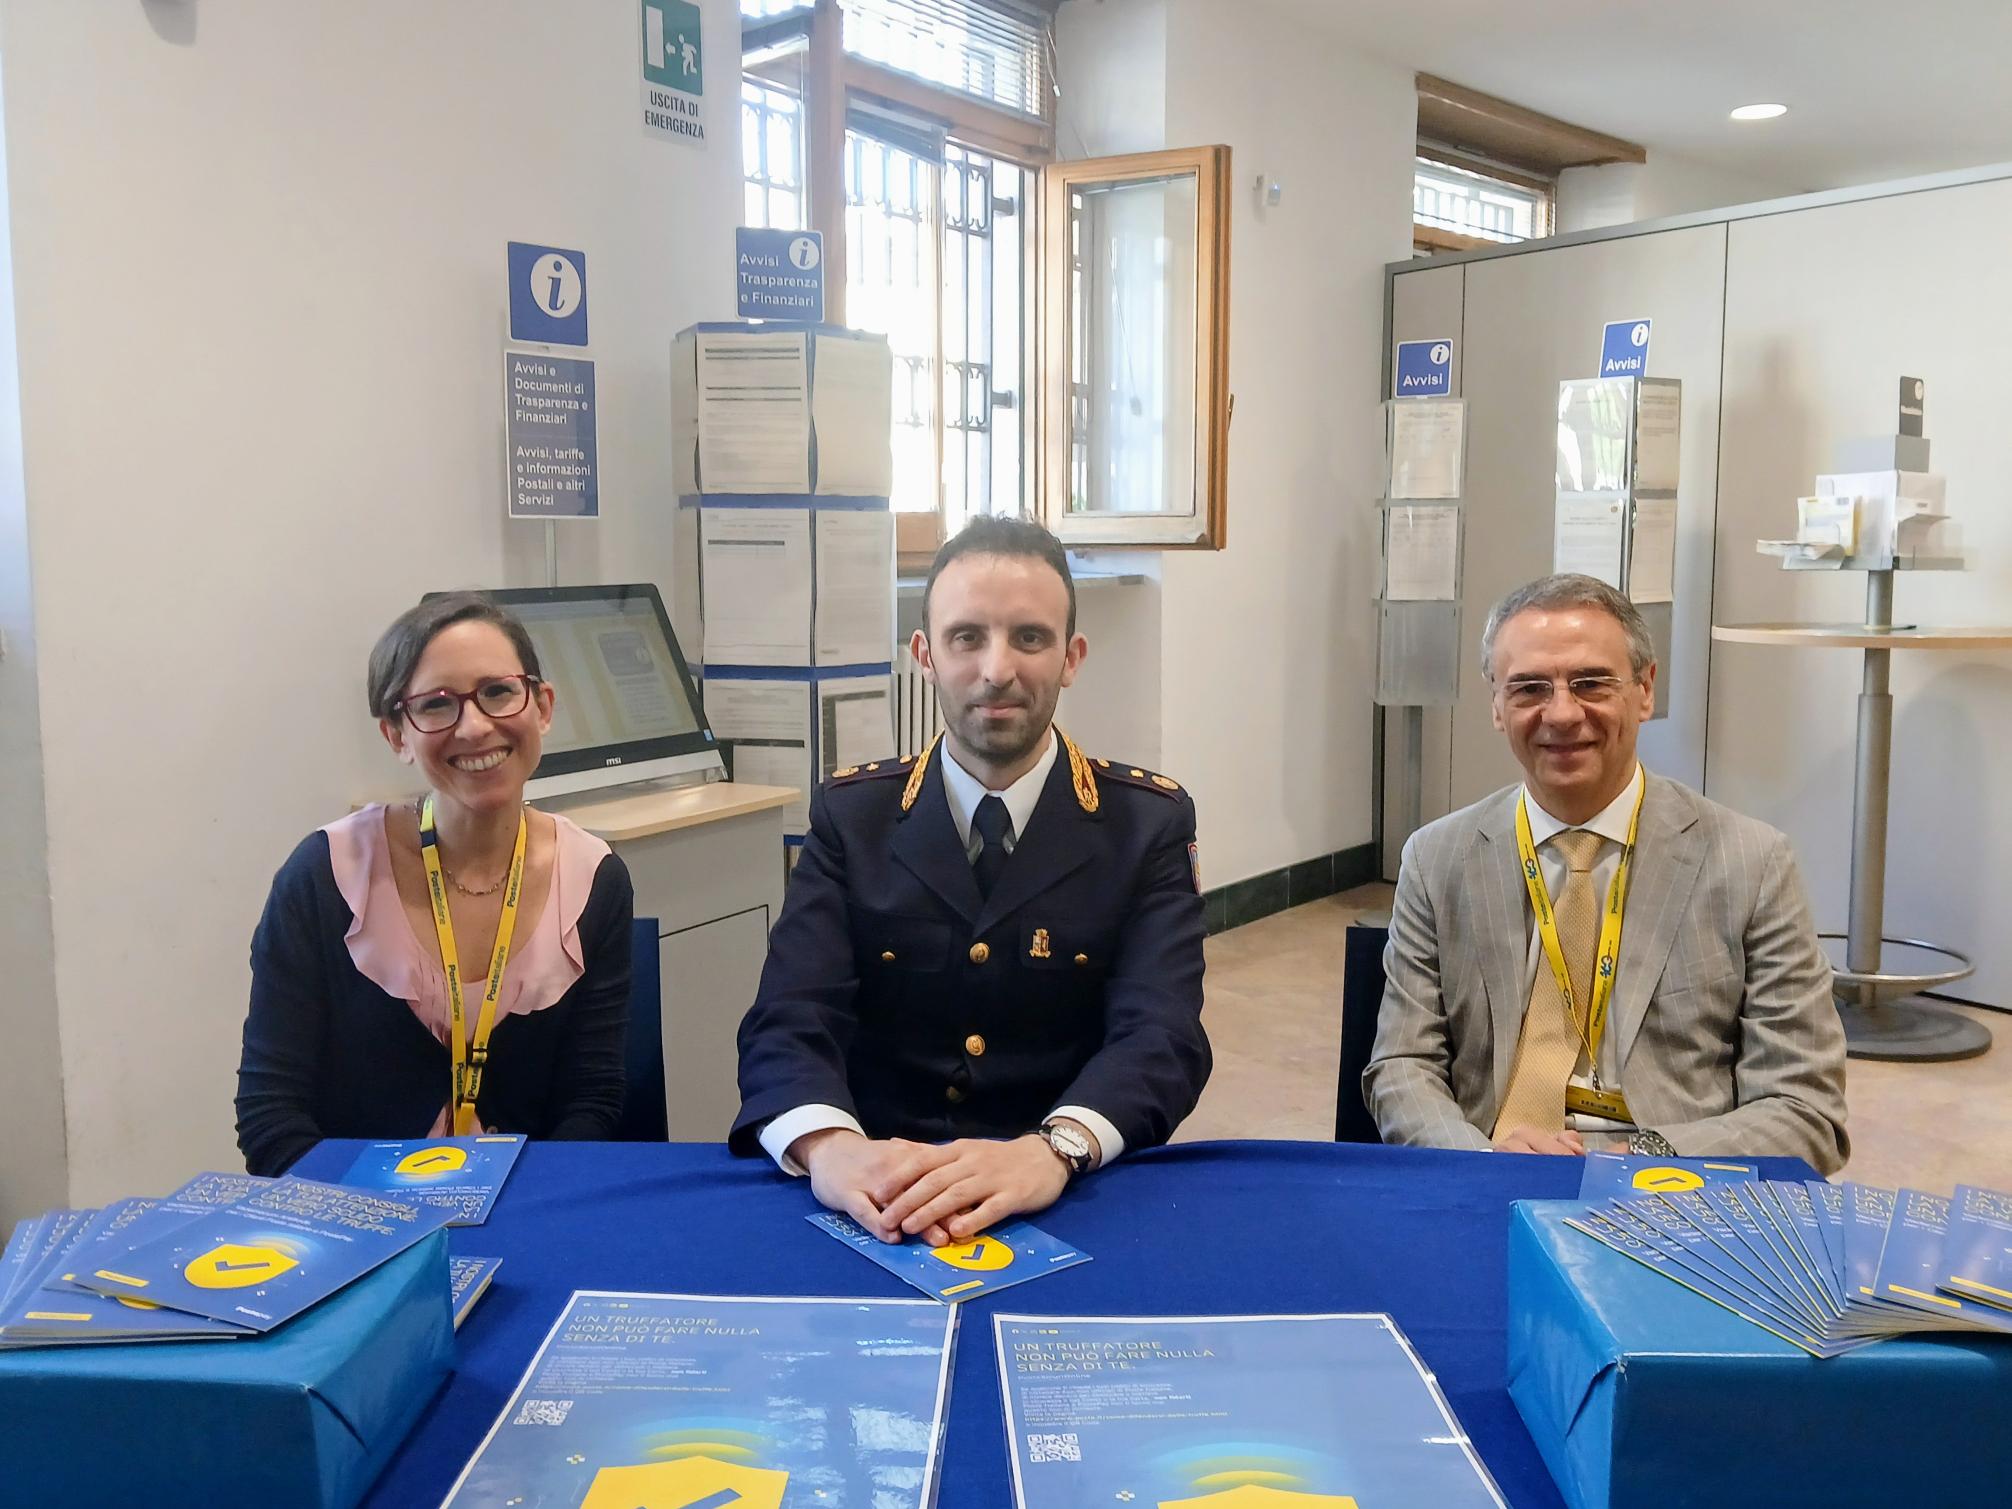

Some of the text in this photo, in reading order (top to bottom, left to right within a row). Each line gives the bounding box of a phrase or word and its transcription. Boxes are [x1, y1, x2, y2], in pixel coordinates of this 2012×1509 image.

[650, 90, 698, 117] USCITA DI
[645, 110, 704, 139] EMERGENZA
[740, 253, 779, 267] Avvisi
[740, 272, 818, 288] Trasparenza
[741, 292, 814, 307] e Finanziari
[515, 361, 556, 376] Avvisi e
[1605, 355, 1641, 372] Avvisi
[515, 378, 584, 394] Documenti di
[1402, 373, 1443, 387] Avvisi
[515, 393, 588, 410] Trasparenza e
[515, 409, 567, 424] Finanziari
[517, 446, 584, 460] Avvisi, tariffe
[517, 462, 591, 476] e informazioni
[518, 477, 585, 491] Postali e altri
[518, 493, 554, 506] Servizi
[606, 757, 622, 767] msi
[575, 1315, 718, 1326] UN TRUFFATORE
[568, 1324, 761, 1336] NON PUÒ FARE NULLA
[562, 1333, 620, 1343] SENZA
[625, 1335, 645, 1344] DI
[1014, 1341, 1162, 1351] UN TRUFFATORE
[1016, 1349, 1215, 1362] NON PUÒ FARE NULLA
[1017, 1363, 1078, 1373] SENZA
[1083, 1362, 1102, 1371] DI
